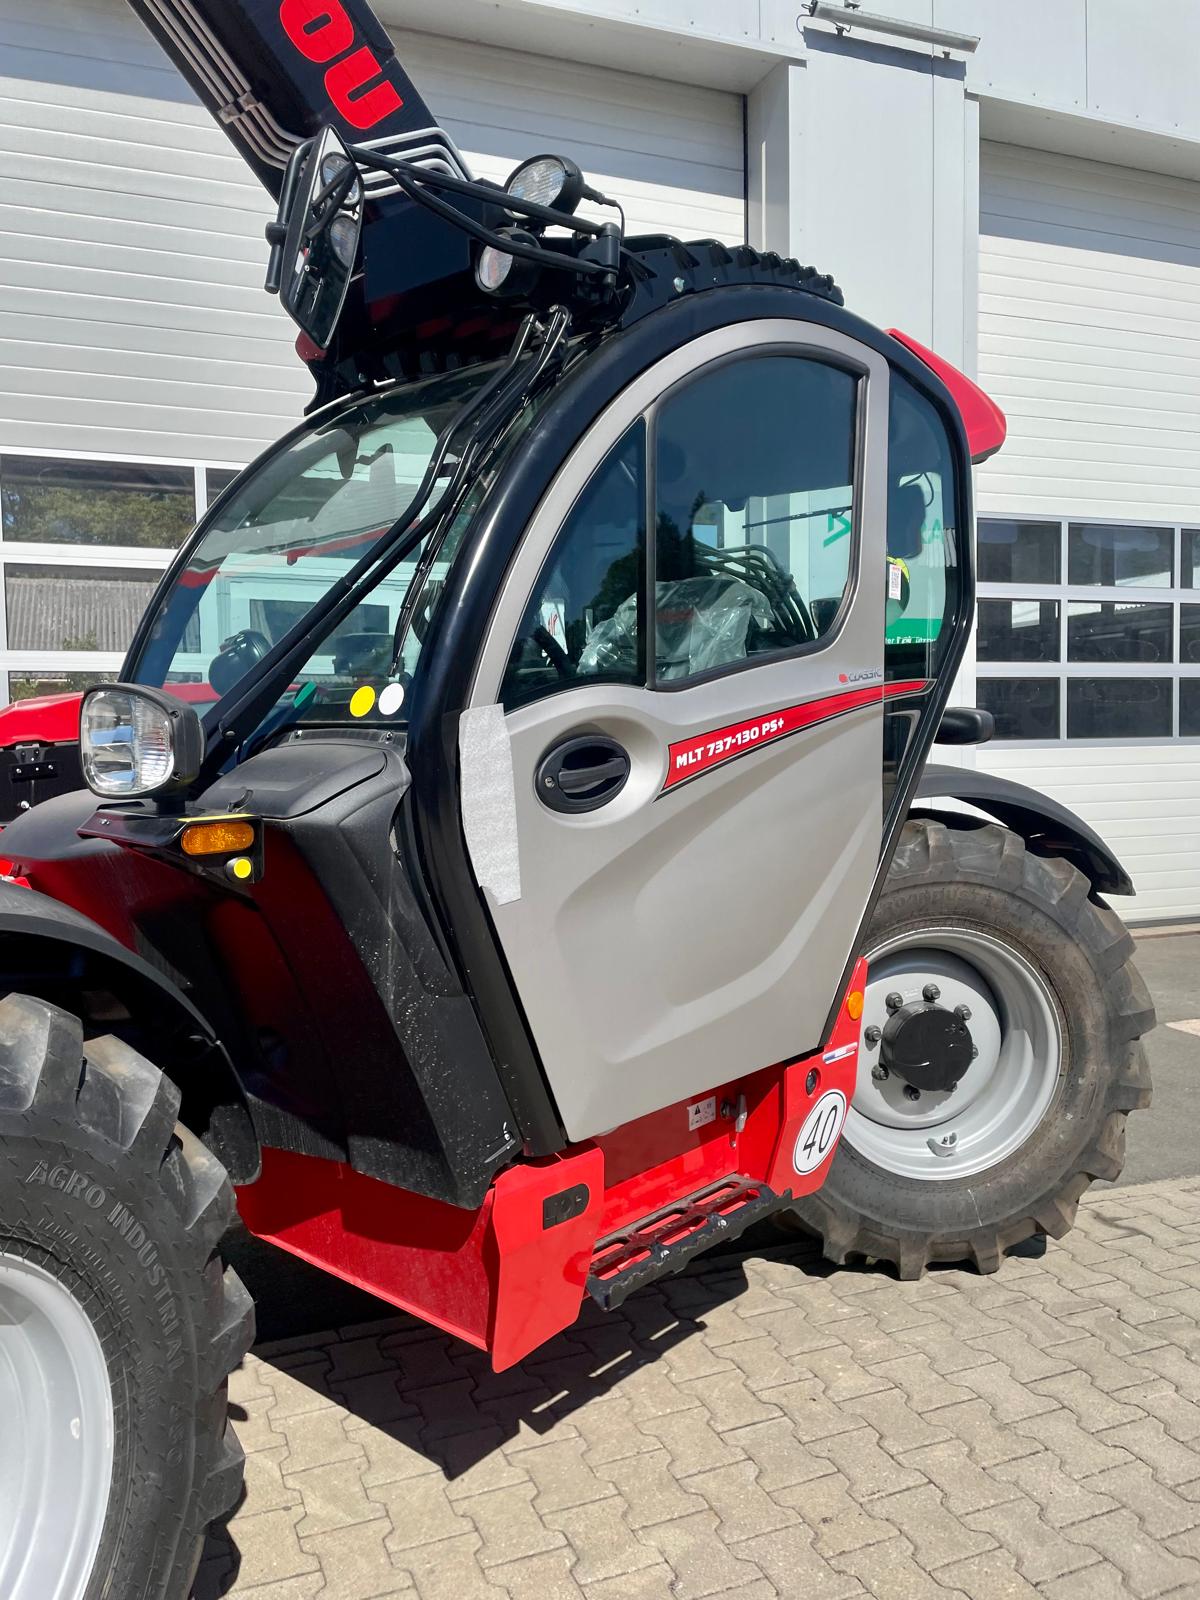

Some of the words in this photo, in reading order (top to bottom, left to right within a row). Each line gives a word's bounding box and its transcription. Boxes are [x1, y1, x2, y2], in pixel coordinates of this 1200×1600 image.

[280, 0, 404, 130] OU
[676, 747, 704, 768] MLT
[707, 727, 759, 756] 737-130
[762, 718, 784, 735] PS+
[802, 1105, 838, 1160] 40
[25, 1159, 106, 1208] AGRO
[107, 1201, 185, 1374] INDUSTRIAL
